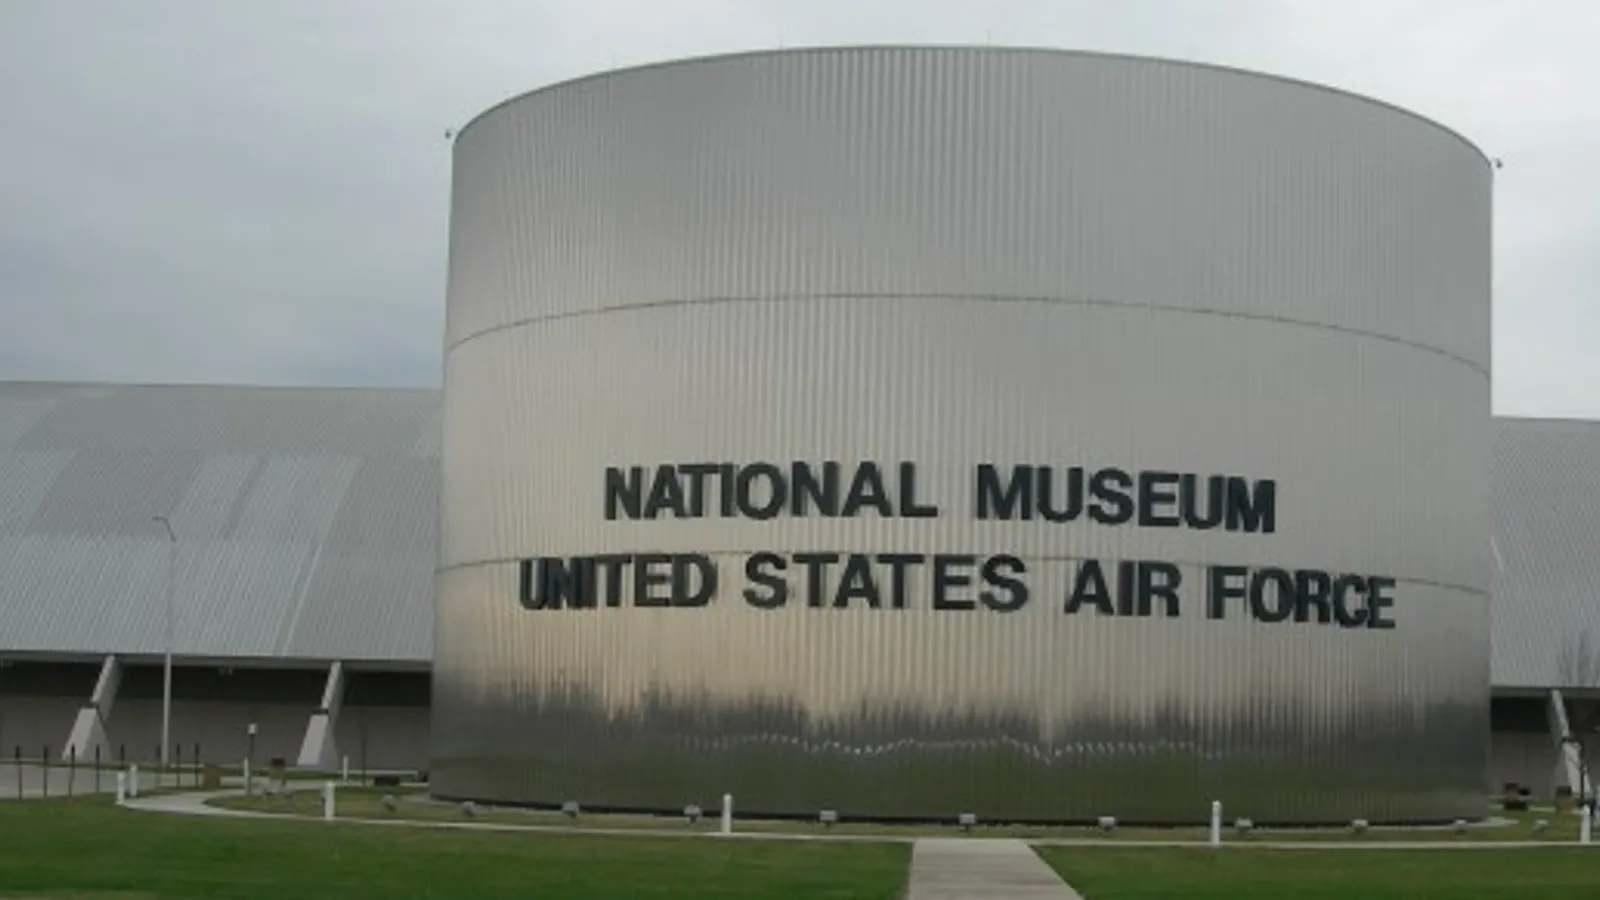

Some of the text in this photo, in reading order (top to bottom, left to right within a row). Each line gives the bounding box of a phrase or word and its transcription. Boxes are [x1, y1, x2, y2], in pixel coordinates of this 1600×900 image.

[605, 460, 1276, 533] NATIONAL MUSEUM
[519, 551, 1397, 630] UNITED STATES AIR FORCE
